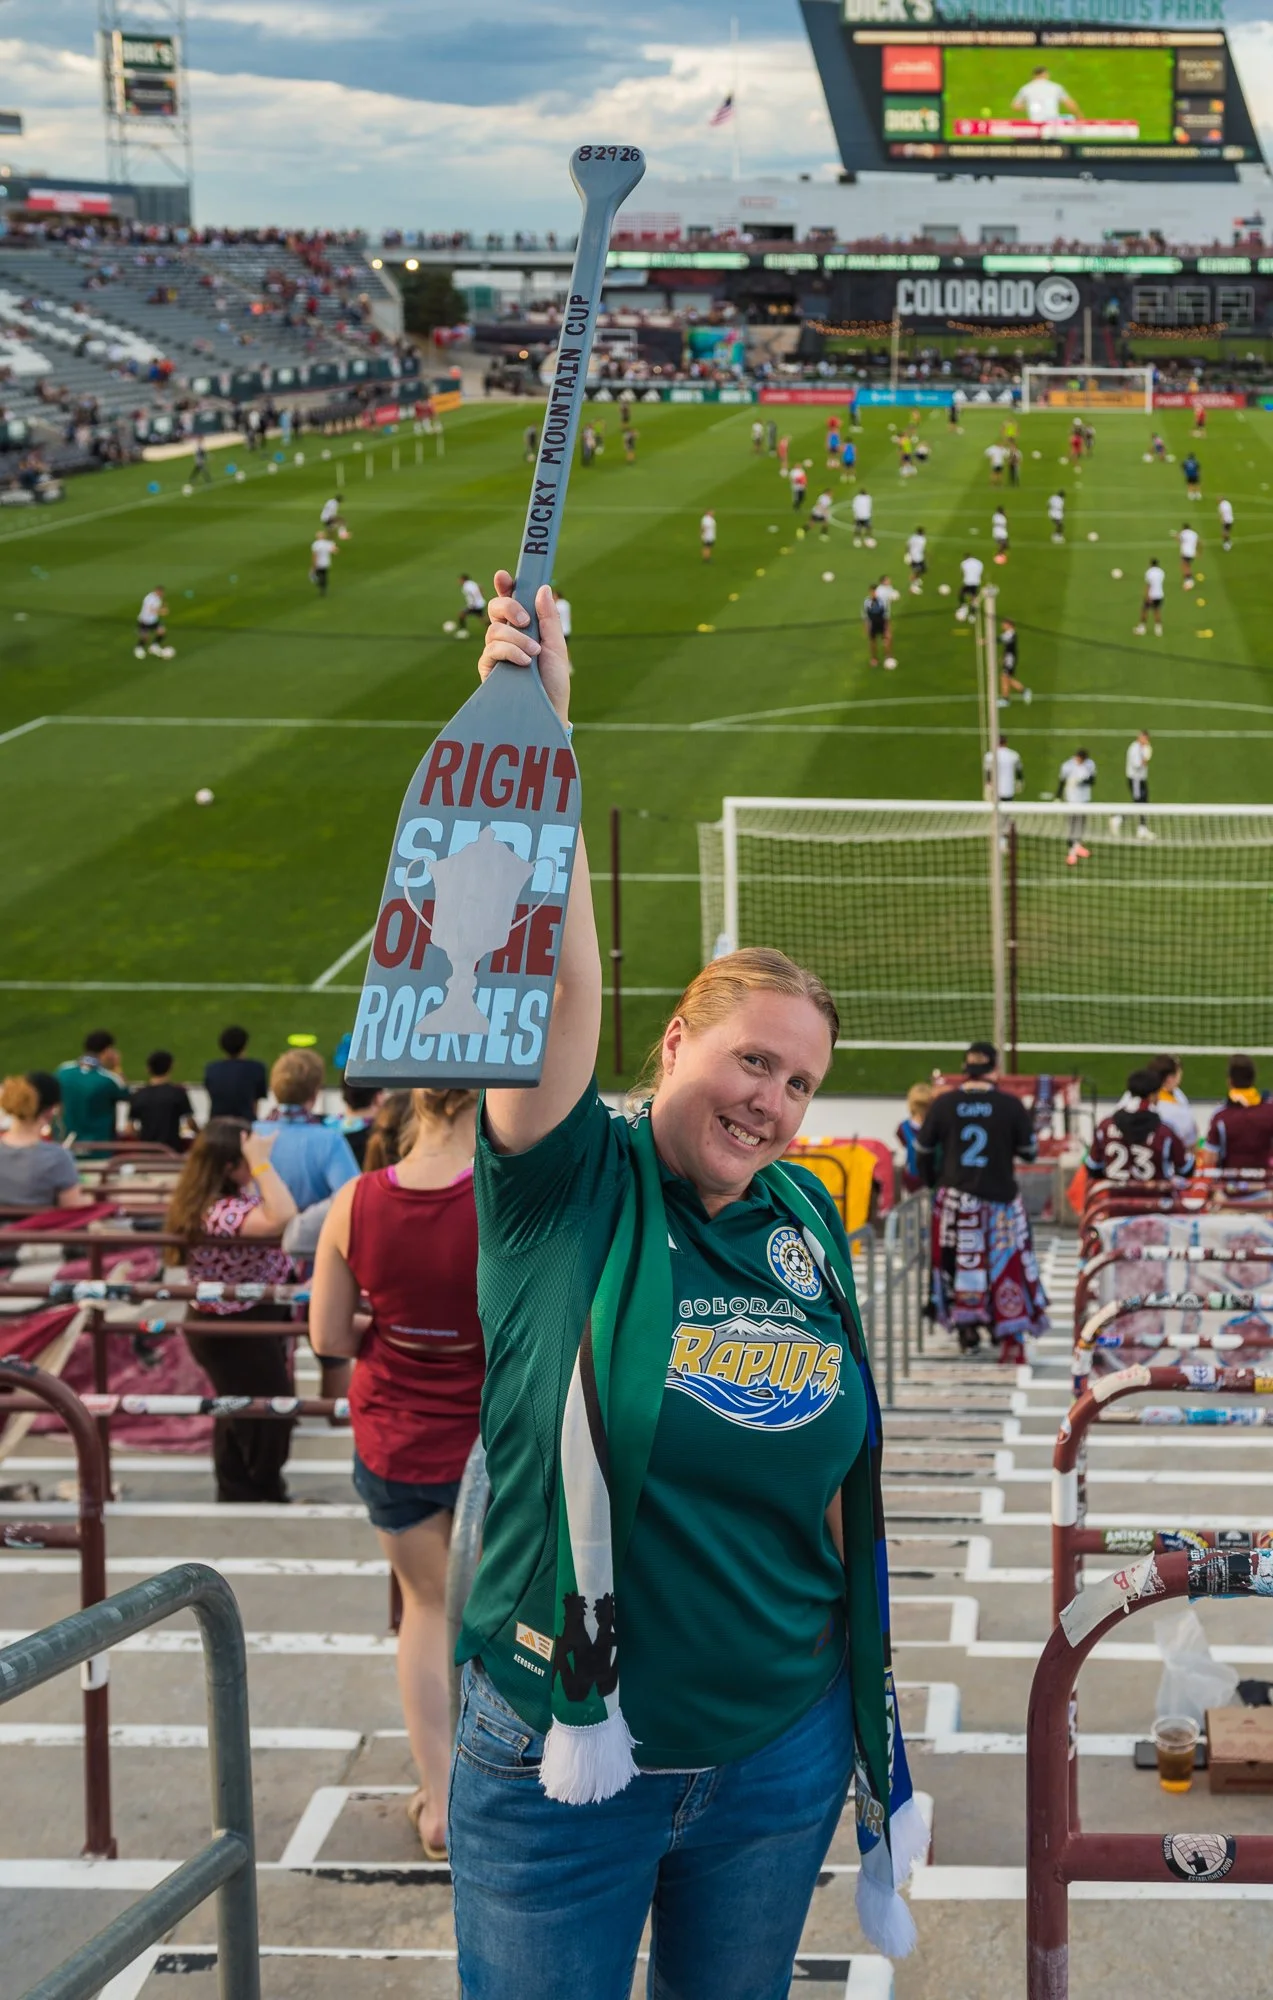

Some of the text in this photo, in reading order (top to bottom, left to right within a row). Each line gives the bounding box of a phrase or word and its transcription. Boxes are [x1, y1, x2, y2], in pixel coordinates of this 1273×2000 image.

[844, 0, 1222, 21] DICKS SPORTING GOODS PARK
[884, 107, 940, 132] DICK'S
[897, 279, 1035, 317] COLORADO
[524, 294, 591, 556] ROCKY MOUNTAIN CUP
[419, 740, 577, 813] RIGHT
[394, 817, 576, 894] SE
[474, 904, 563, 976] HE
[956, 1102, 992, 1117] CAPO
[960, 1124, 989, 1168] 2
[1105, 1141, 1155, 1181] 23
[679, 1297, 806, 1321] COLORAD
[671, 1322, 842, 1395] RAPIDS
[513, 1653, 545, 1677] AEROREADY
[1188, 1857, 1233, 1882] ESTABLISHED 2009
